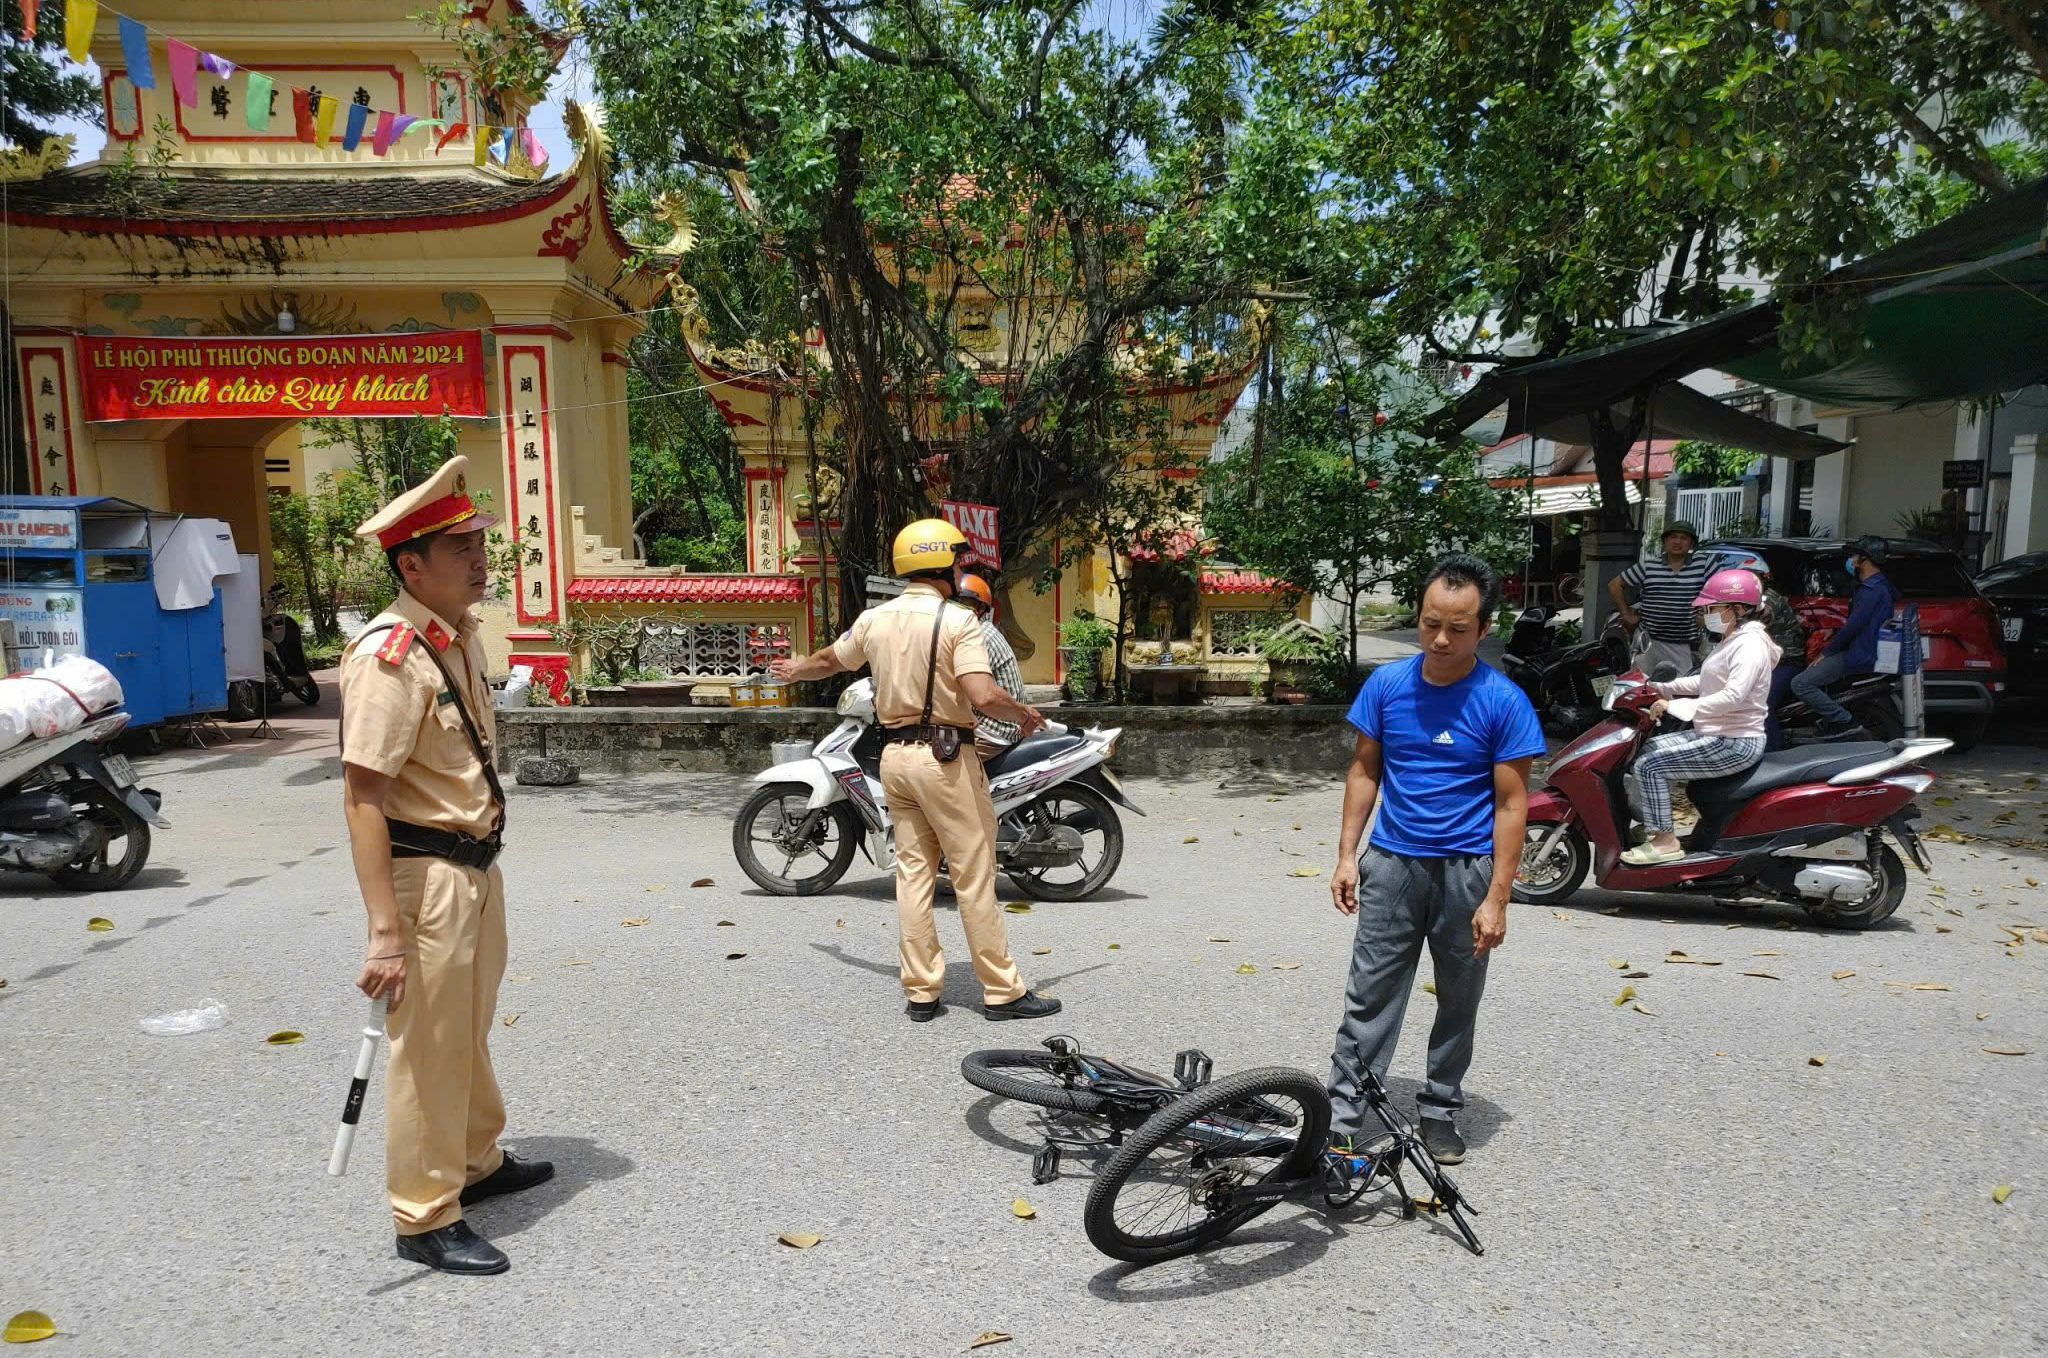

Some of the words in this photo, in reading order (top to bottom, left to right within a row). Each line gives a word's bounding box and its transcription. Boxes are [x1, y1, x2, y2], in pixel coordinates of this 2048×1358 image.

[94, 342, 115, 368] LỄ
[119, 345, 157, 372] HỘI
[161, 342, 202, 367] PHỦ
[206, 344, 292, 371] THƯỢNG
[296, 346, 356, 369] ĐOẠN
[361, 342, 409, 365] NĂM
[412, 344, 465, 364] 2024
[134, 376, 210, 407] Kính
[216, 376, 278, 404] chào
[280, 376, 348, 411] Quý
[352, 373, 430, 402] khách
[18, 523, 70, 537] CAMERA
[943, 504, 995, 540] TAXI
[910, 541, 948, 554] CSGT
